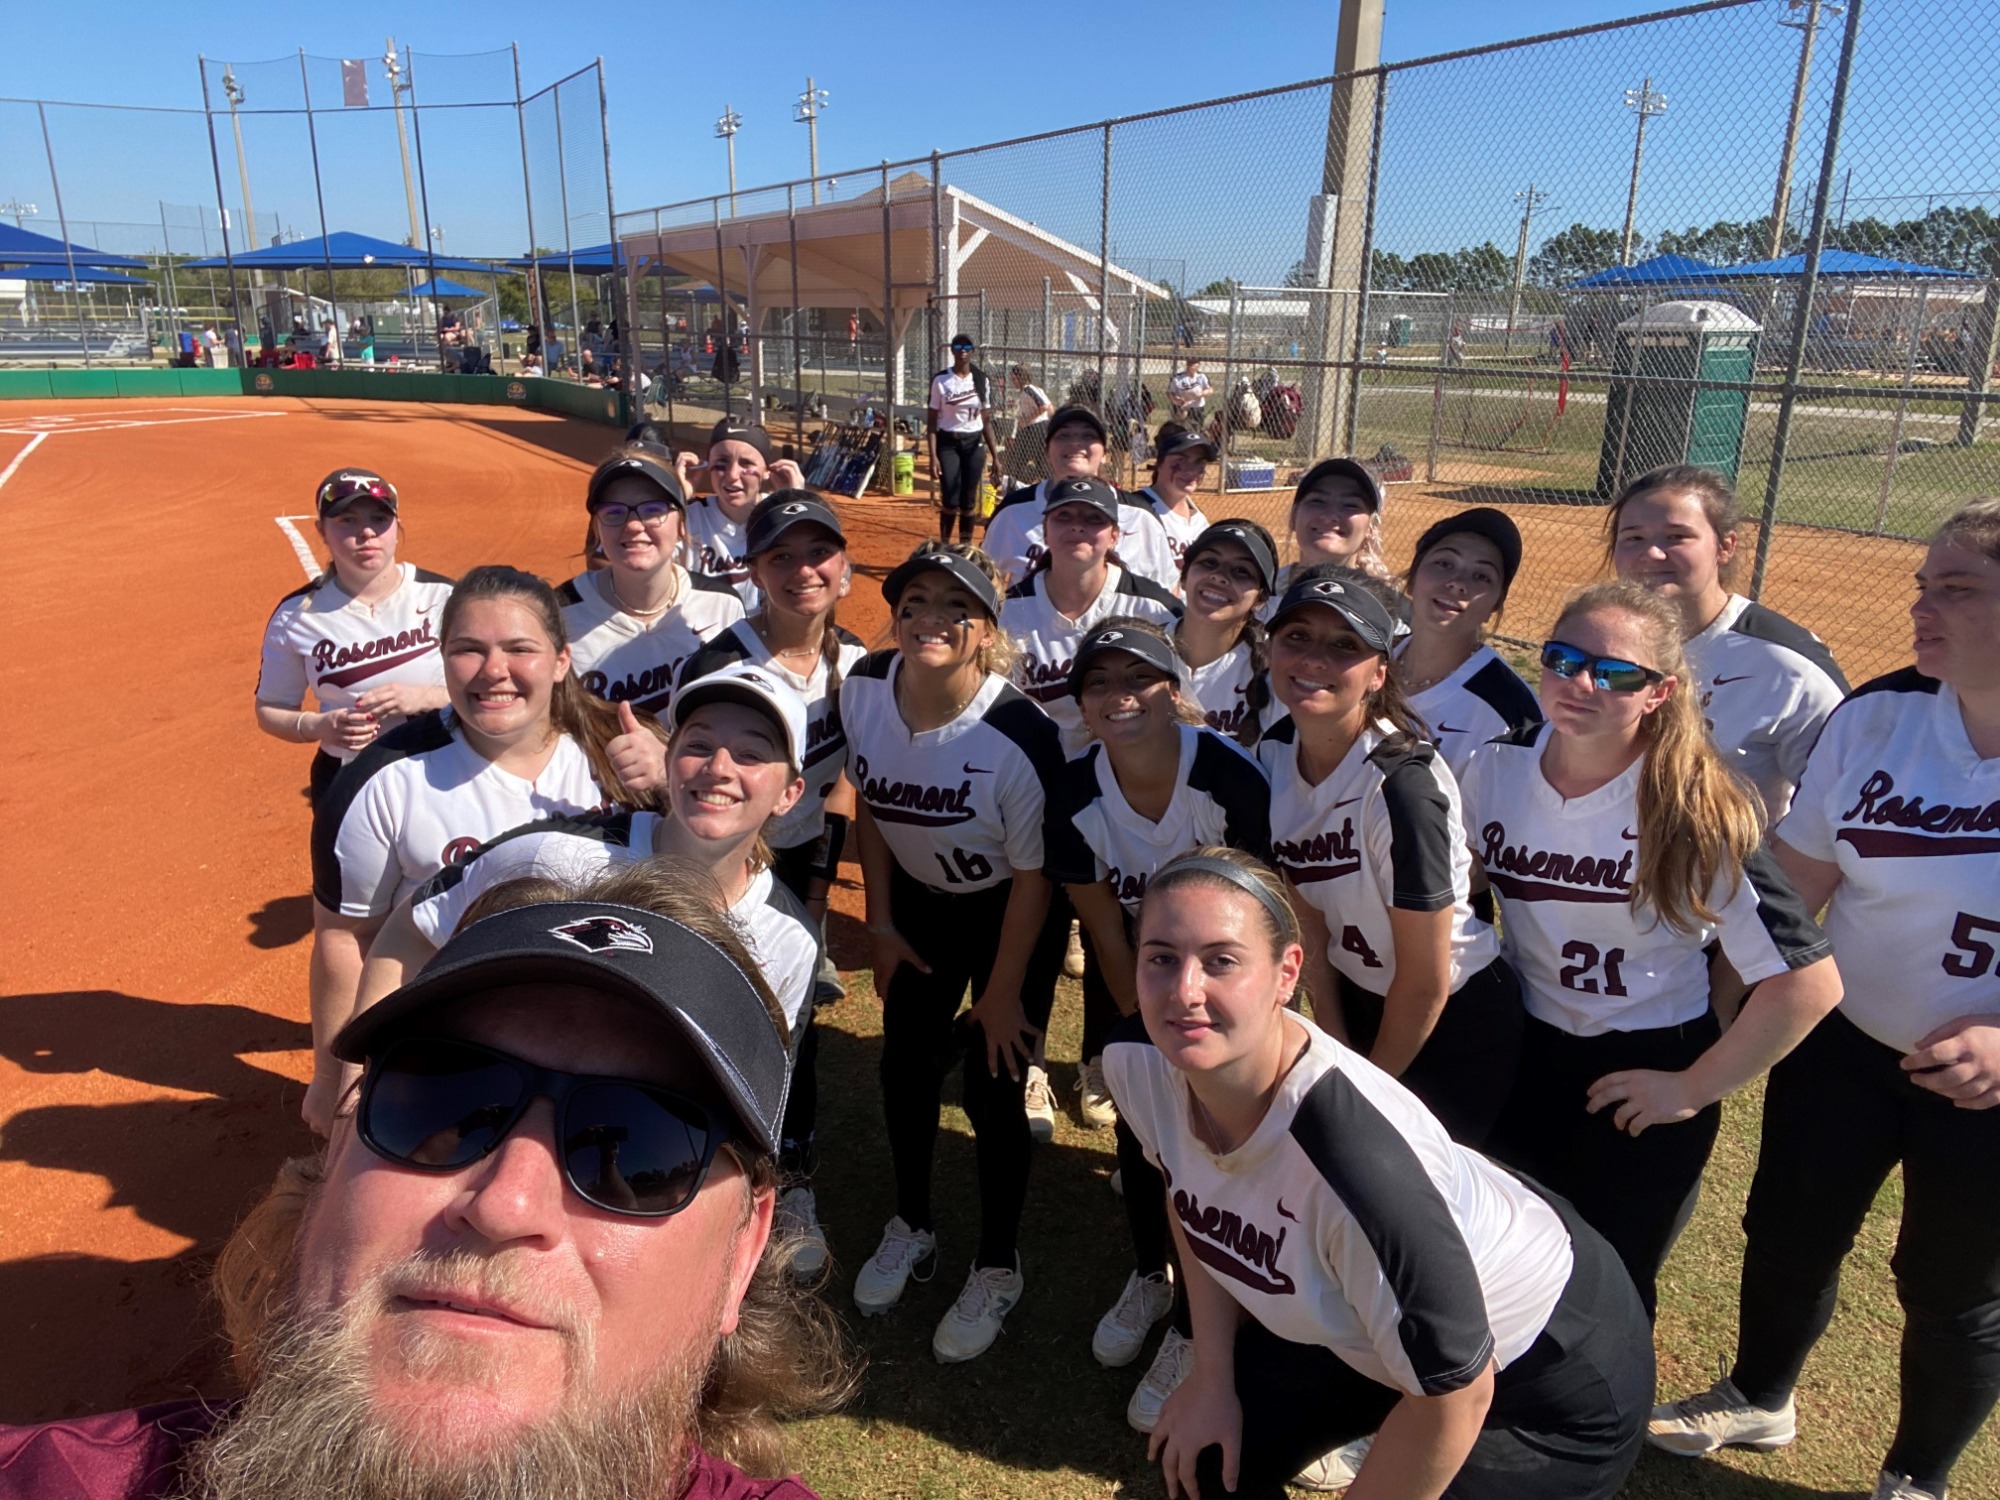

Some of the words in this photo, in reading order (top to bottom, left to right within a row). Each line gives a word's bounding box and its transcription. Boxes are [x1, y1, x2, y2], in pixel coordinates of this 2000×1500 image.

[312, 617, 436, 672] Rosemont
[1021, 652, 1073, 685] Rose
[855, 755, 971, 814] Rosemont
[1842, 770, 2000, 833] Rosemo
[935, 848, 993, 883] 16
[1480, 821, 1633, 890] Rosemont
[1342, 925, 1384, 968] 4
[1560, 940, 1628, 997] 21
[1942, 912, 2000, 979] 5
